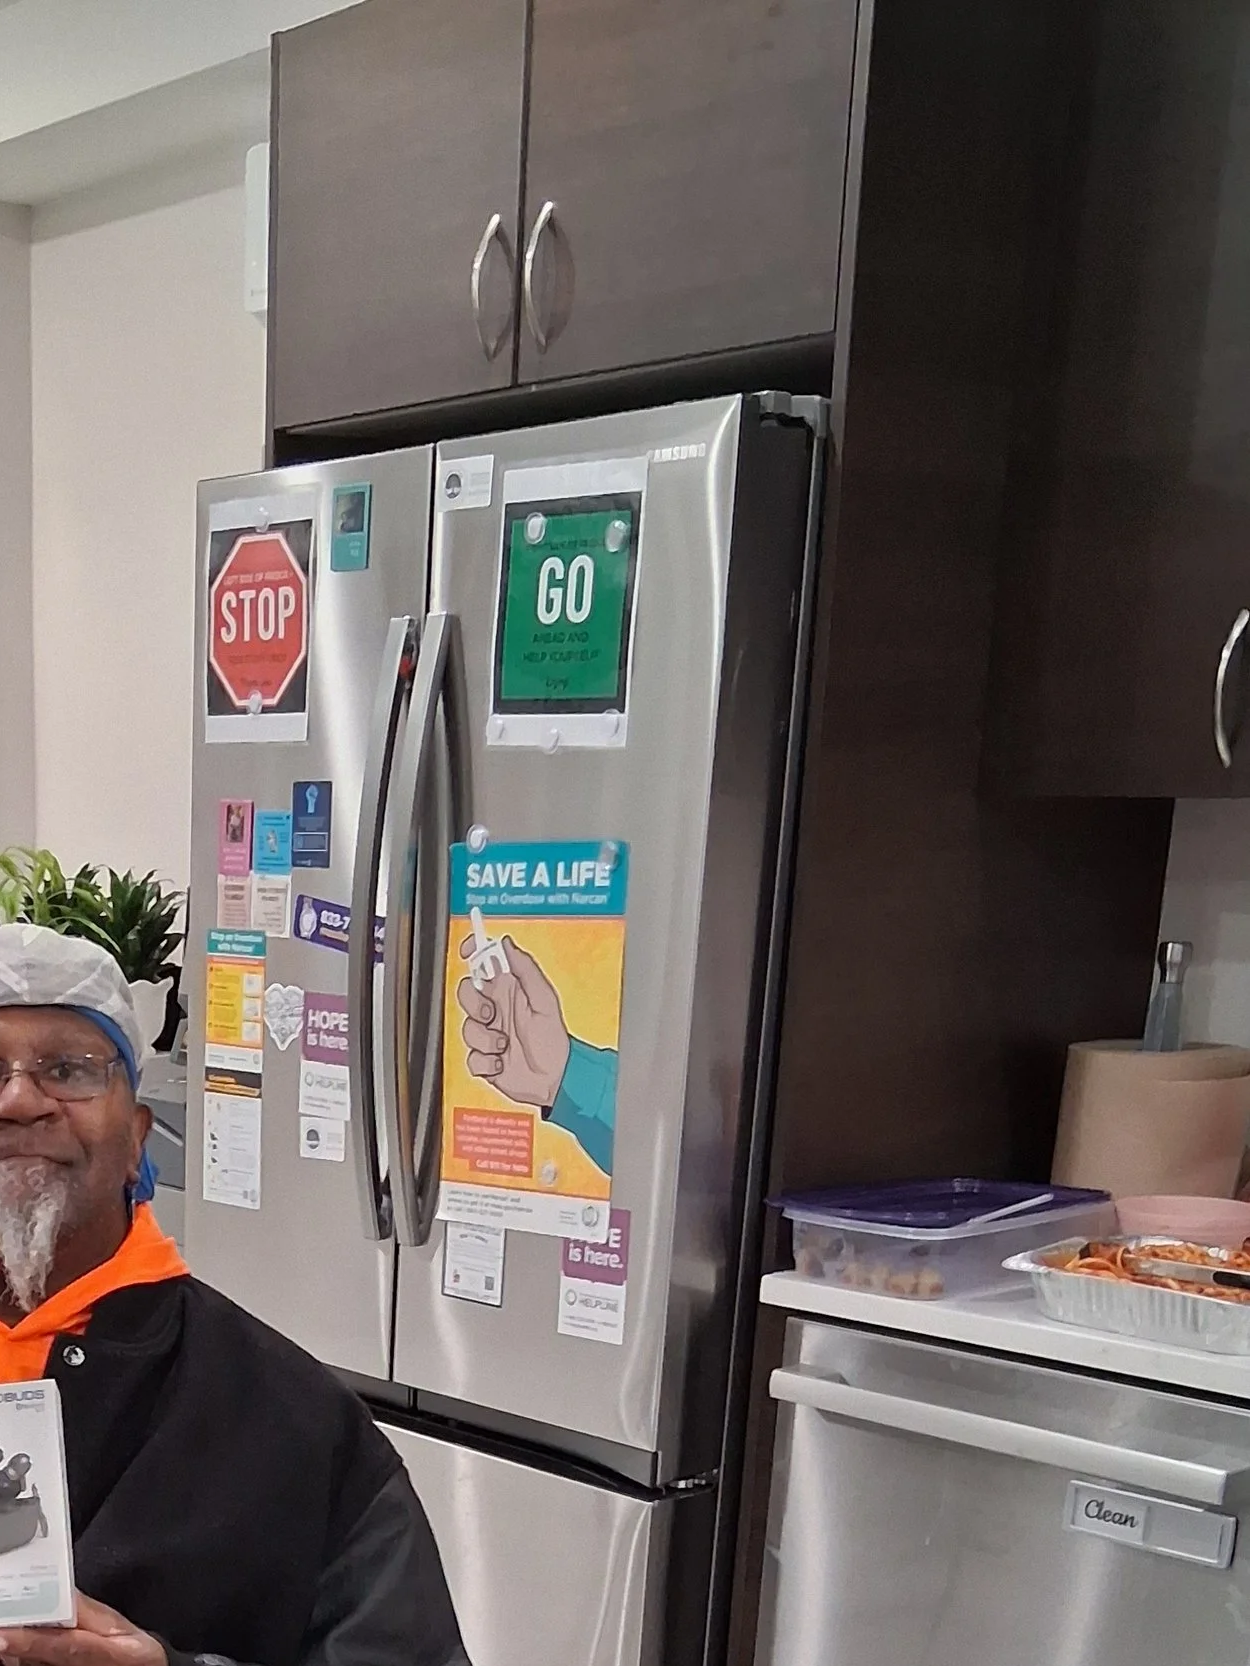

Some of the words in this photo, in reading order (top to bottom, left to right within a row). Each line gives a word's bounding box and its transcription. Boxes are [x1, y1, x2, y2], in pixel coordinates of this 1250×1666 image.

[537, 554, 594, 625] GO
[220, 586, 296, 644] STOP
[466, 861, 527, 889] SAVE
[530, 861, 551, 888] A
[556, 860, 611, 888] LIFE
[308, 1009, 349, 1032] HOPE
[307, 1029, 318, 1046] is
[569, 1243, 582, 1262] is
[583, 1246, 624, 1270] here.
[1083, 1498, 1138, 1529] Clean
